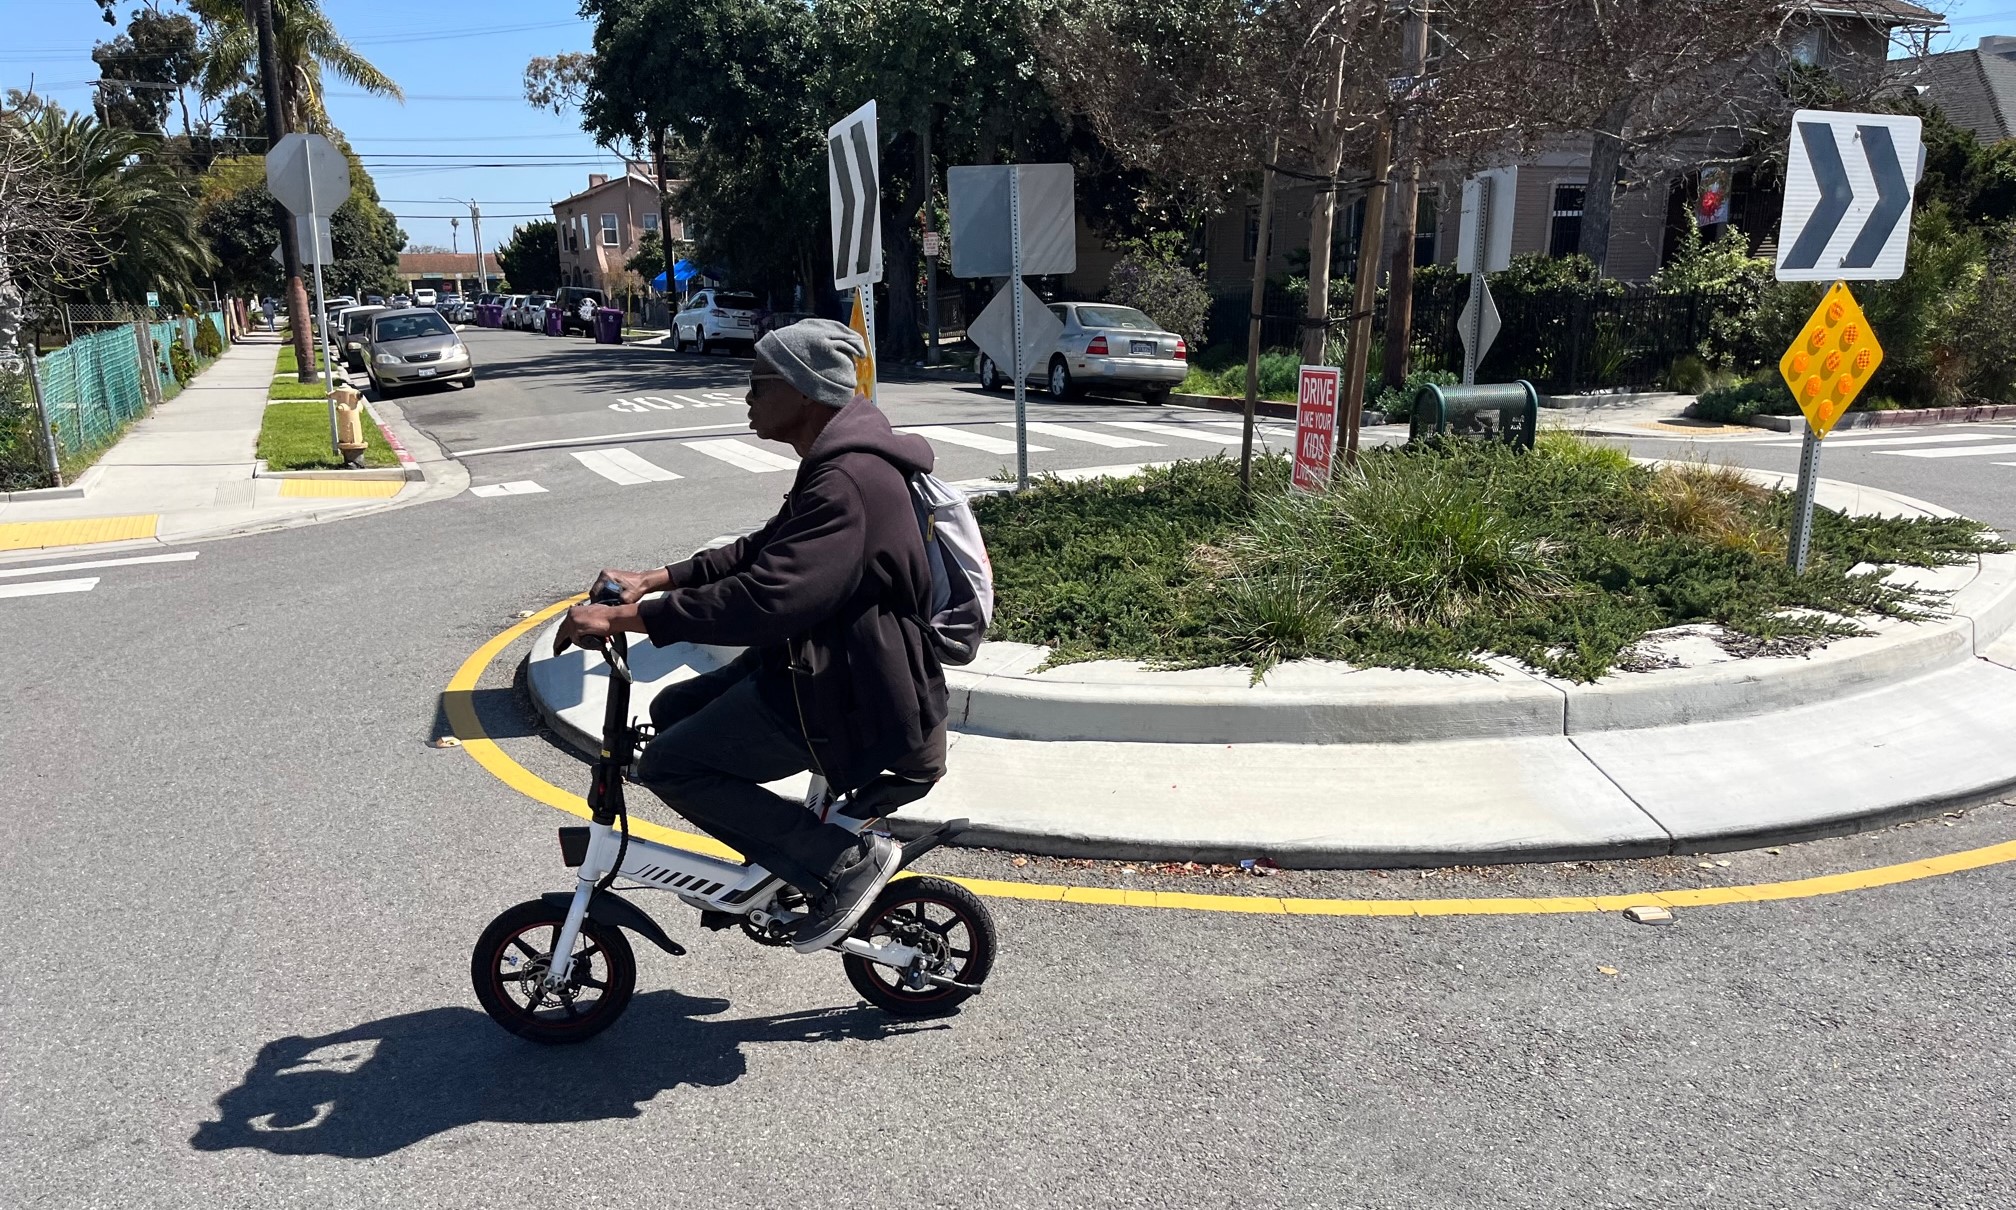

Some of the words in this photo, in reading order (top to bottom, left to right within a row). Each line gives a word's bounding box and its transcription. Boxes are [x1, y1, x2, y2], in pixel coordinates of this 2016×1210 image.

[608, 392, 747, 413] STOP
[1303, 377, 1334, 406] DRIVE
[1300, 410, 1314, 428] LIKE
[1315, 412, 1332, 431] YOUR
[1302, 432, 1325, 461] KIDS
